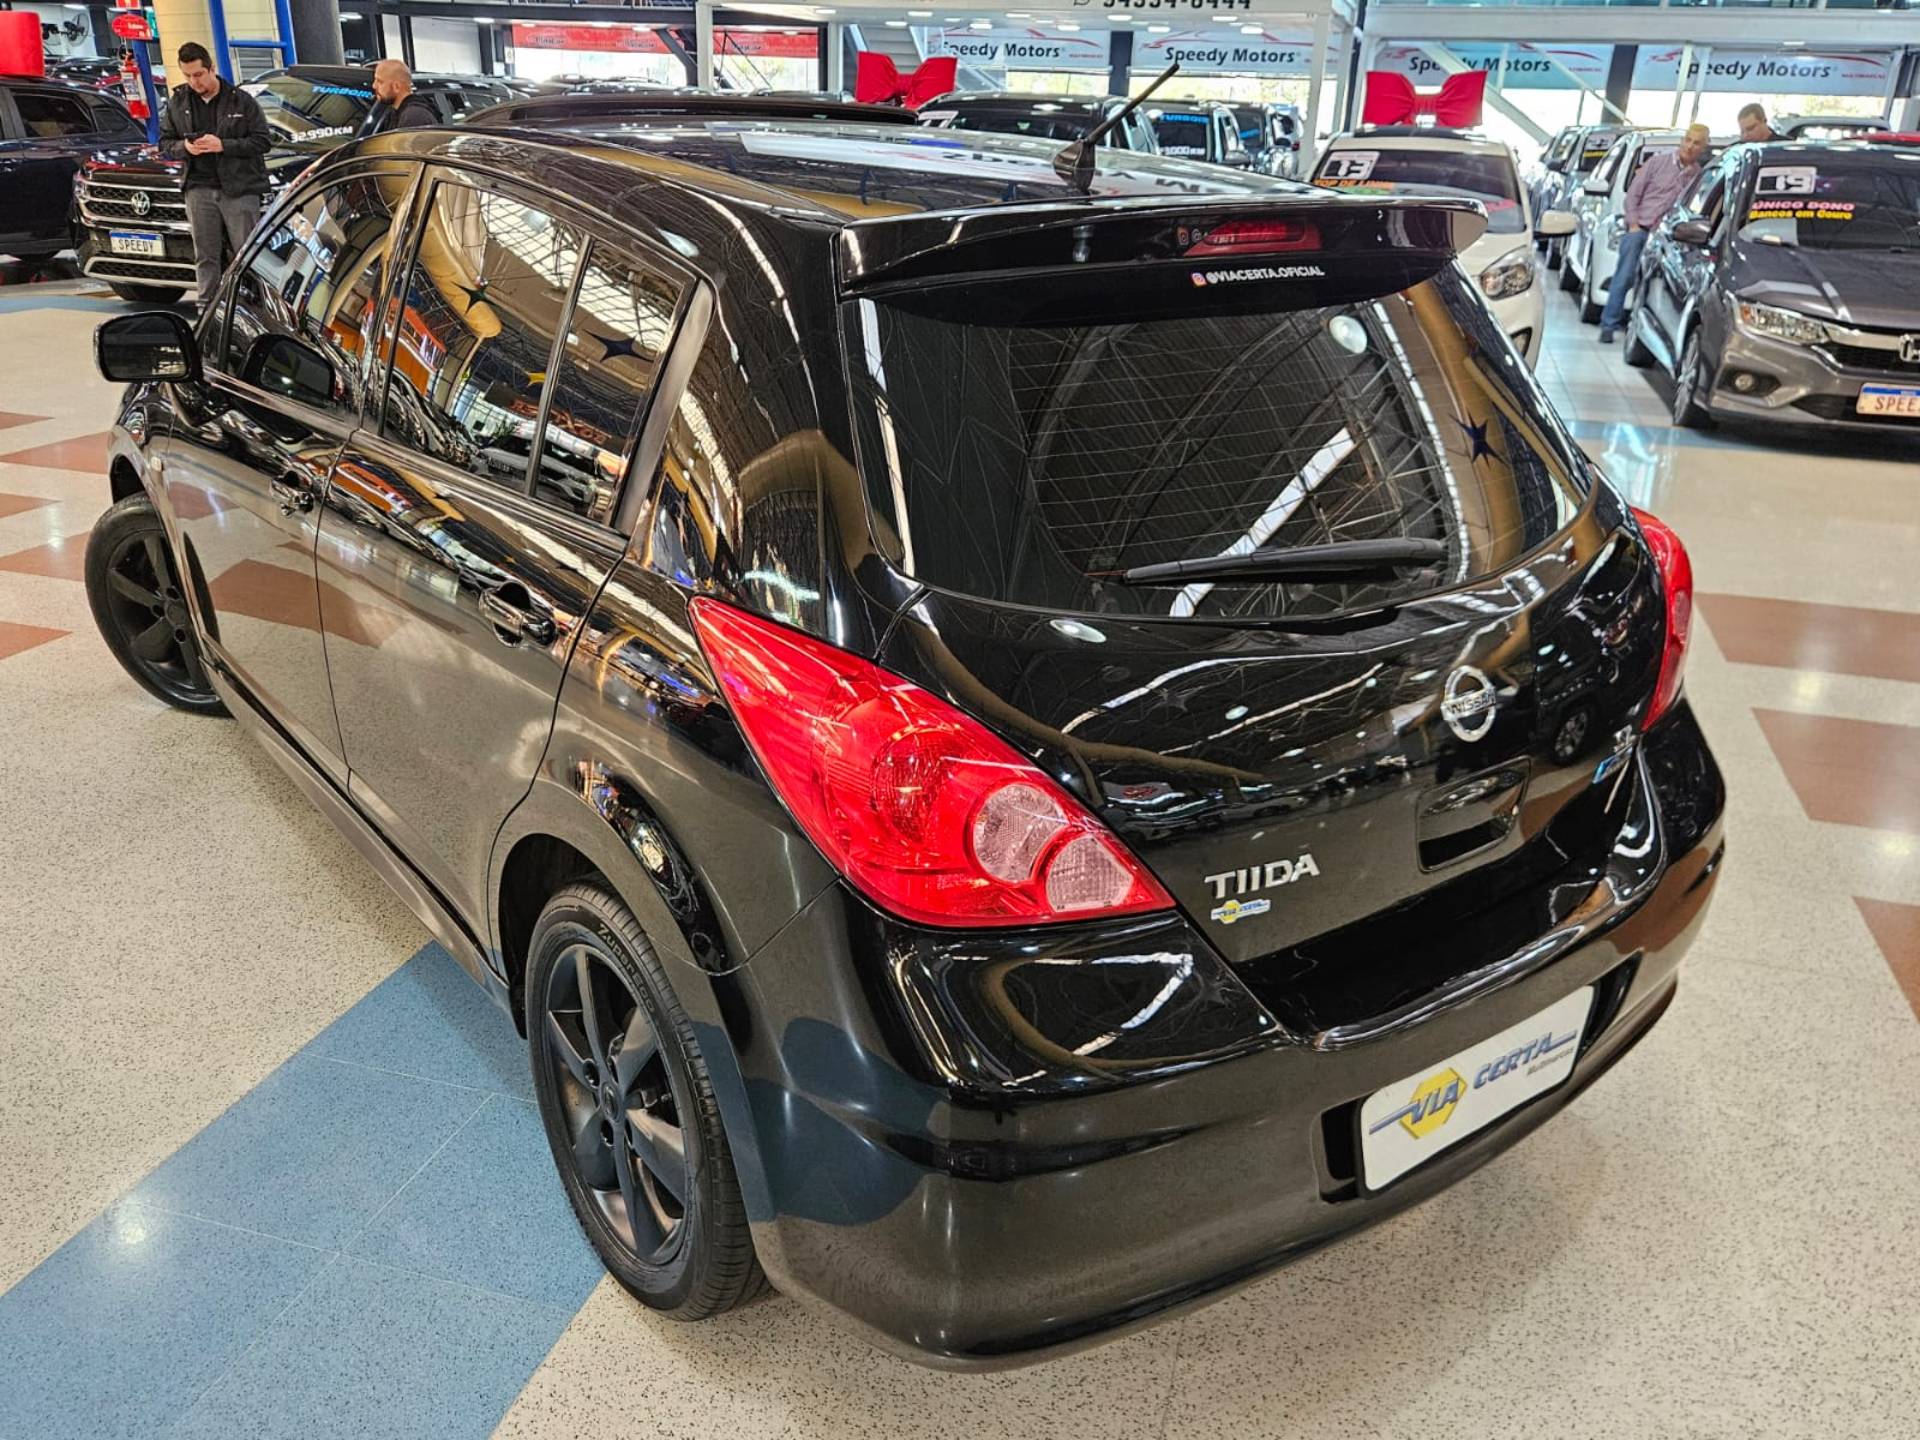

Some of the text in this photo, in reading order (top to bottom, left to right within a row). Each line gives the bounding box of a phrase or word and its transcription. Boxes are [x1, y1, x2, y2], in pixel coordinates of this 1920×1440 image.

[943, 42, 1060, 60] peedy Motors
[1165, 47, 1295, 66] Speedy Motors
[1409, 56, 1478, 75] Spey
[1756, 61, 1831, 78] Motors
[334, 126, 354, 136] KM
[1337, 160, 1371, 180] 13
[1775, 174, 1812, 193] 19
[1807, 202, 1856, 212] DONO
[118, 239, 154, 253] SPEEDY
[1206, 266, 1326, 284] @VIACERTA.OFICIAL
[1874, 396, 1920, 412] SPEE
[1203, 853, 1320, 900] TIIDA
[1408, 1076, 1461, 1126] VIA
[1472, 1031, 1554, 1091] CERTA
